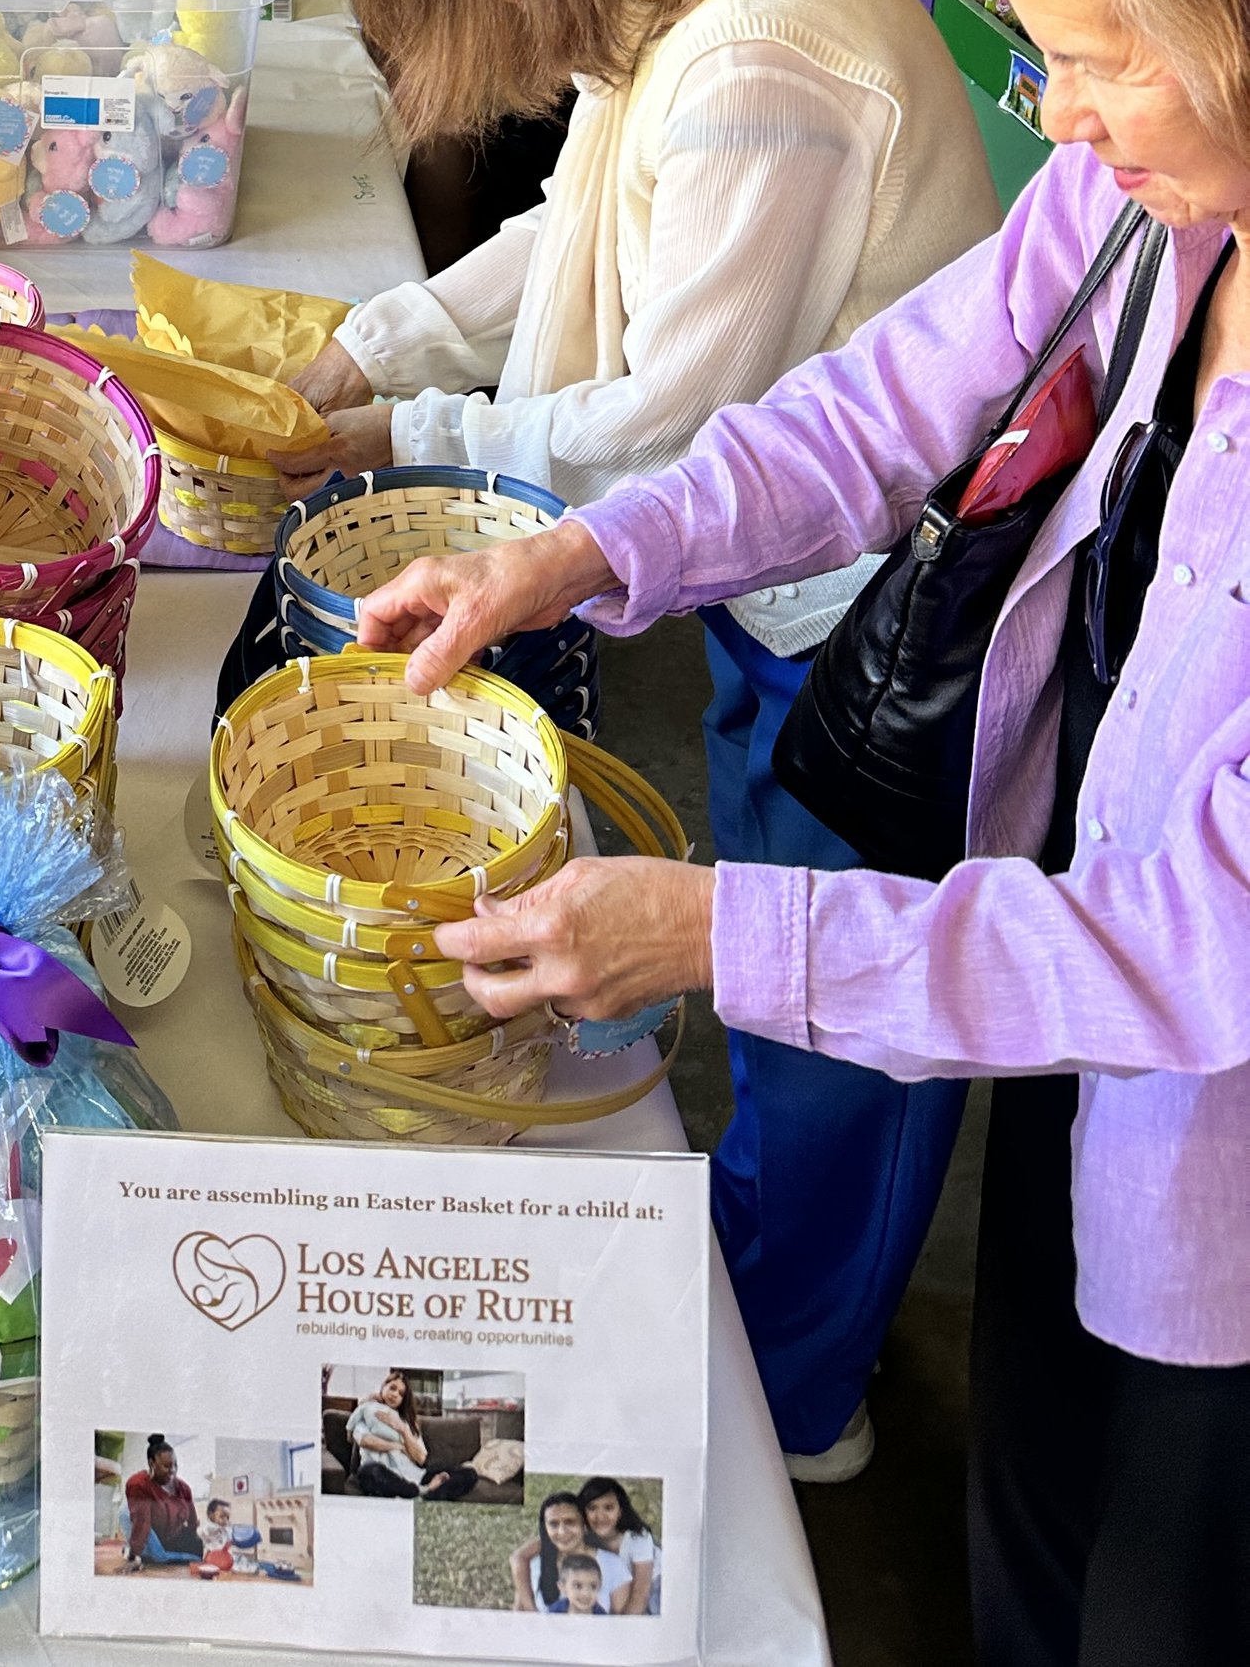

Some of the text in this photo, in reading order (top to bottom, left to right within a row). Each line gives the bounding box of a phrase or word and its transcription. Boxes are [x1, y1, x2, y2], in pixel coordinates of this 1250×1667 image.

[118, 1181, 664, 1221] You are assembling an Easter Basket for a child at:
[297, 1243, 530, 1283] LOS ANGELES
[296, 1281, 574, 1324] HOUSE OF RUTH
[296, 1322, 574, 1347] rebuilding lives, creating opportunities
